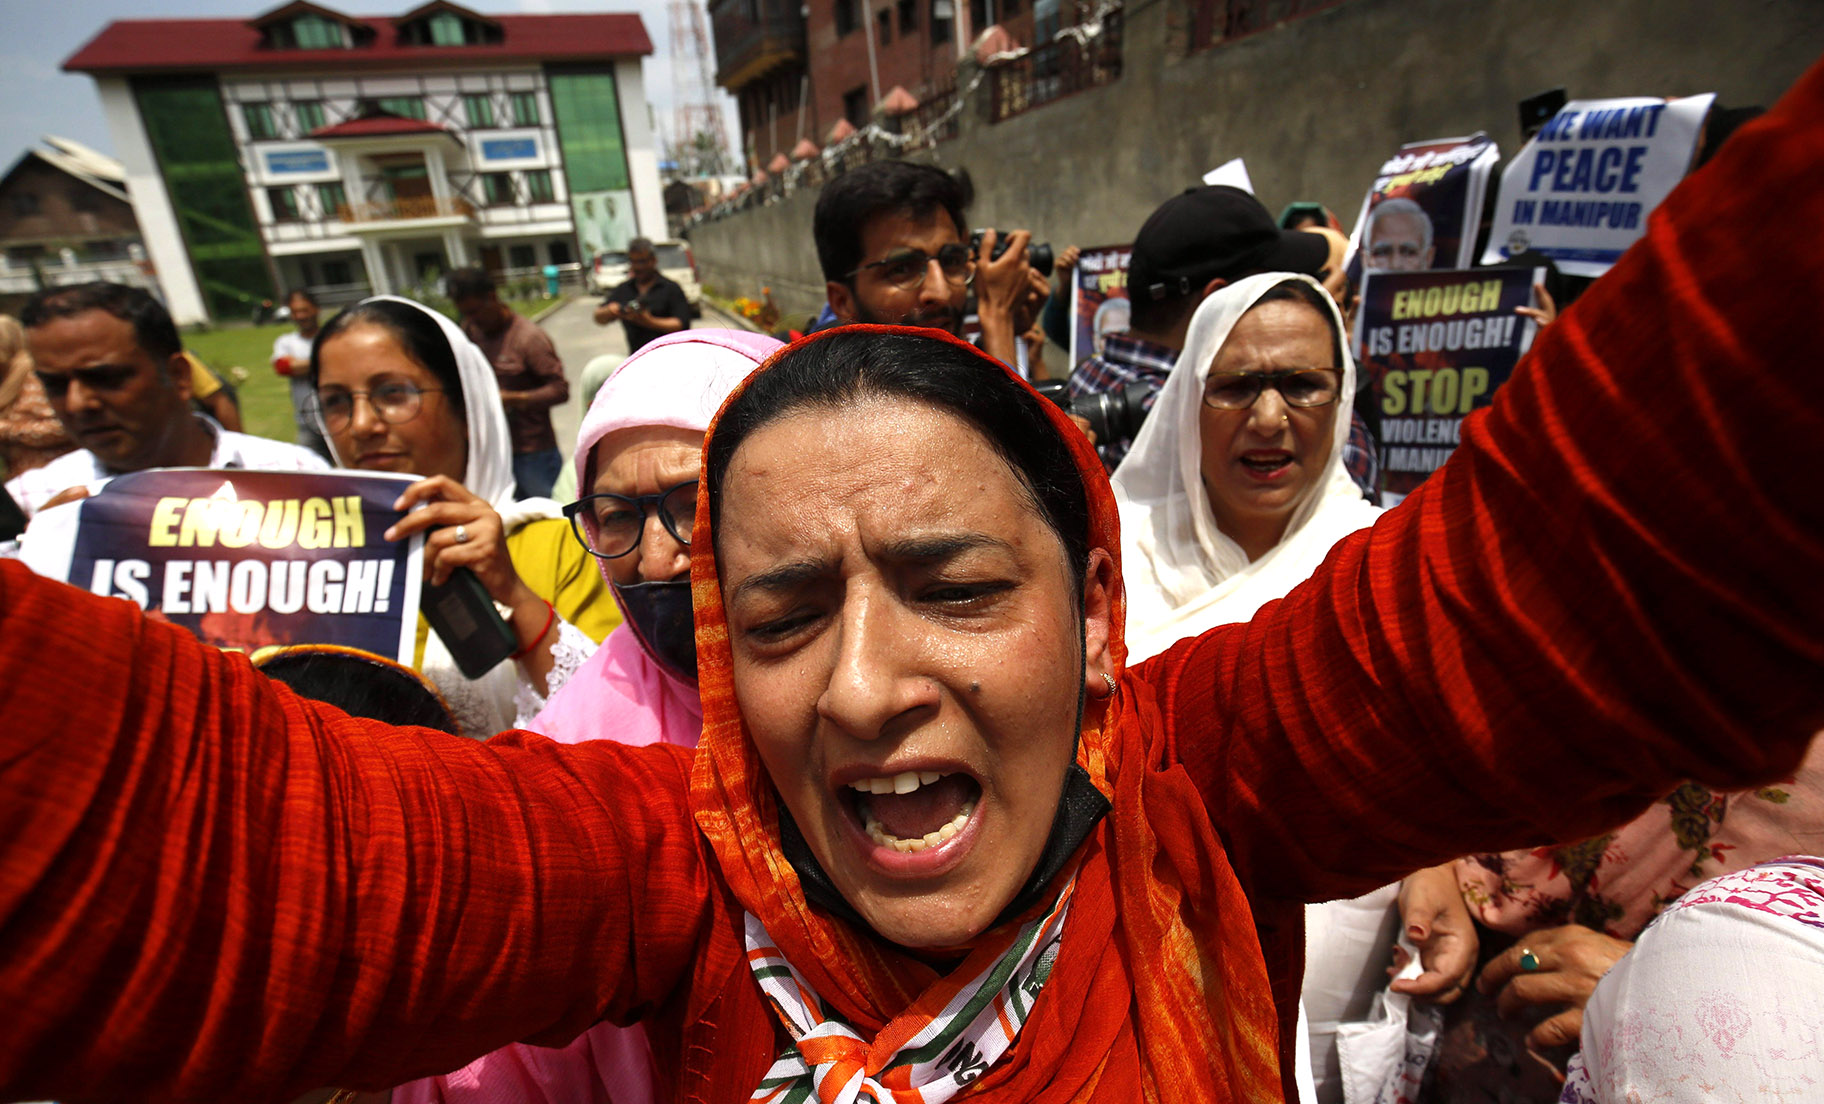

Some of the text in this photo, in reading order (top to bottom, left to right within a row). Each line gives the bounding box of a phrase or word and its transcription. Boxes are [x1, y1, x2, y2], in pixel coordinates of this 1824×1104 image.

[1579, 104, 1667, 140] WANT
[1528, 146, 1648, 194] PEACE
[1512, 200, 1643, 230] IN MANIPUR
[1392, 279, 1503, 320] ENOUGH
[1368, 315, 1516, 356] IS ENOUGH!
[1382, 367, 1489, 415] STOP
[149, 496, 366, 549] ENOUGH
[90, 559, 395, 614] IS ENOUGH!
